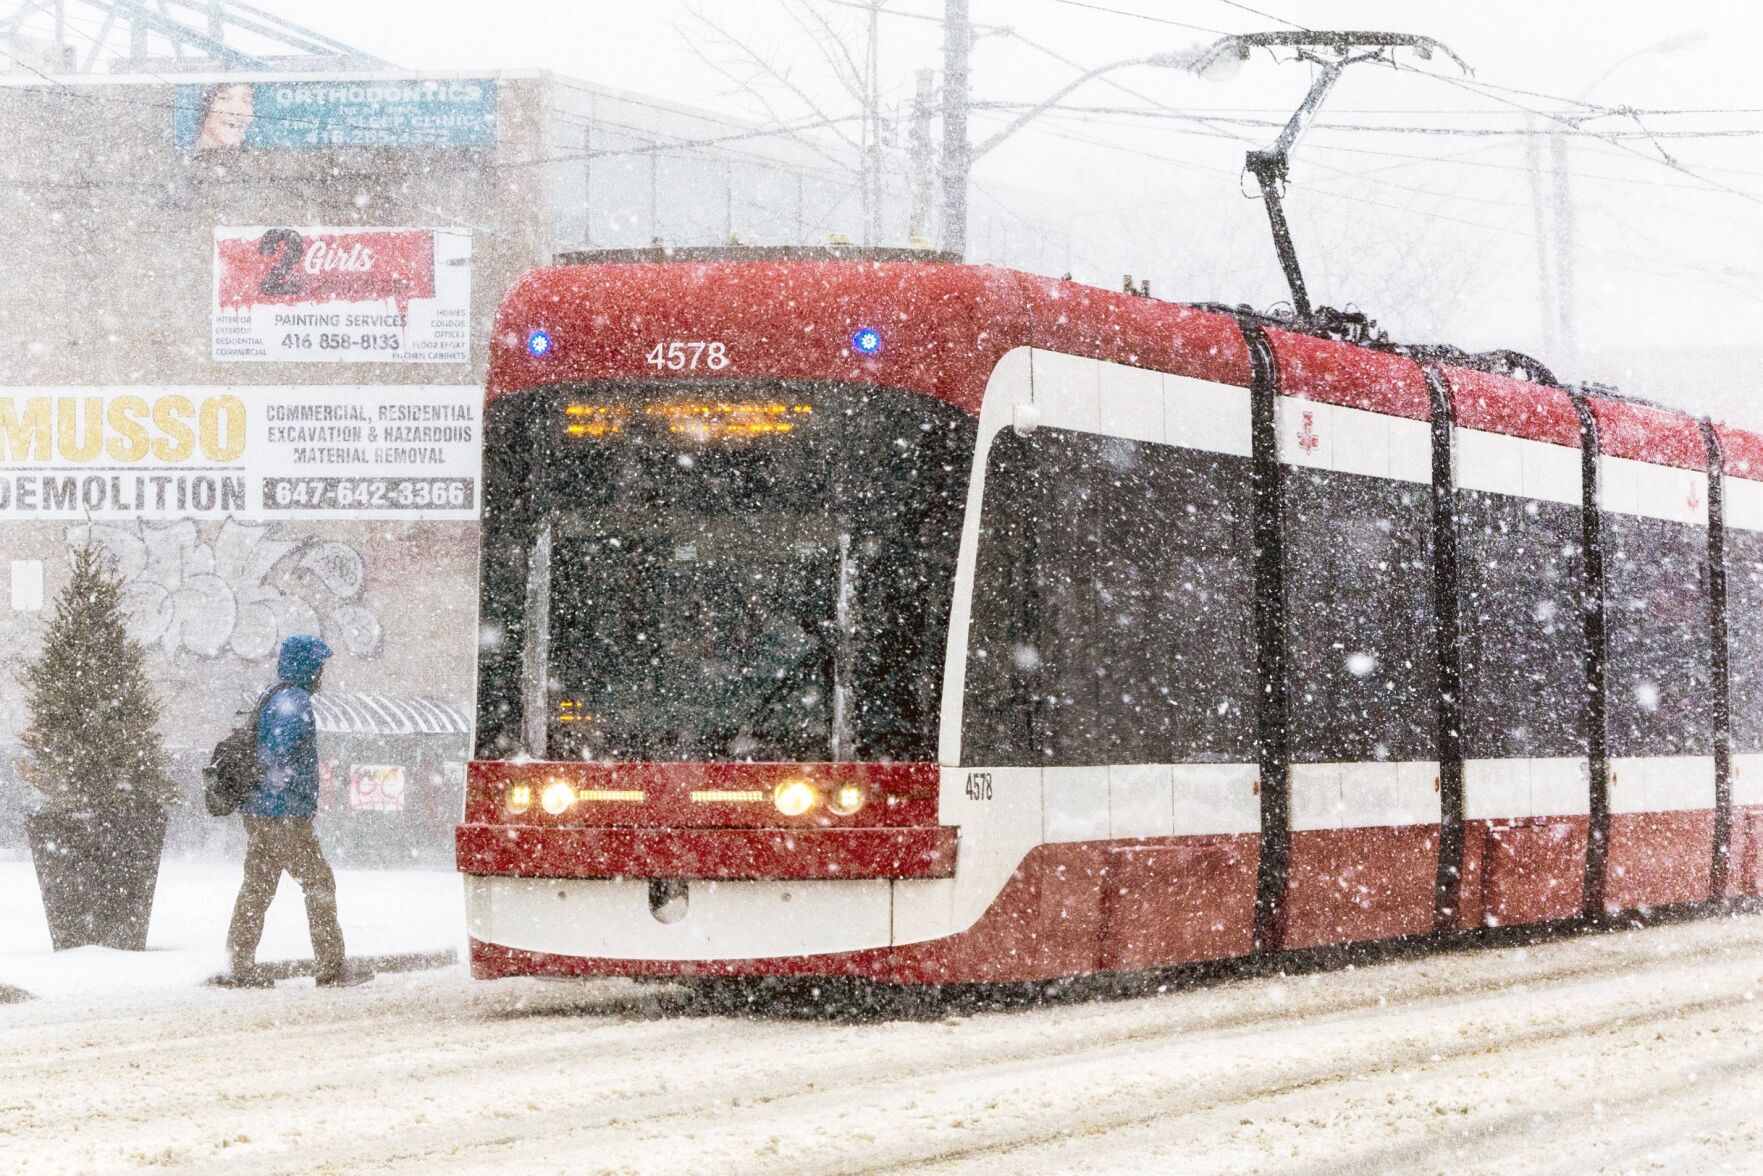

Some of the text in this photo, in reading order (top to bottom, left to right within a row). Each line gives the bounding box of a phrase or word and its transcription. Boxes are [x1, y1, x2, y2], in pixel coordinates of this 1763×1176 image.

[276, 86, 482, 104] ORTHODONTICS
[259, 229, 375, 296] 2 Girls
[274, 314, 408, 328] PAINTING SERVICES
[215, 337, 264, 345] RESIDENTIAL
[281, 333, 400, 350] 416 858-8133
[215, 348, 268, 356] COMMERCIAL
[646, 341, 728, 370] 4578
[266, 405, 474, 424] COMMERCIAL, RESIDENTIAL
[0, 394, 247, 462] MUSSO
[268, 427, 472, 443] EXCAVATION & HAZARDOUS
[293, 447, 446, 464] MATERIAL REMOVAL
[275, 482, 465, 505] 647-642-3366
[966, 773, 993, 801] 4578
